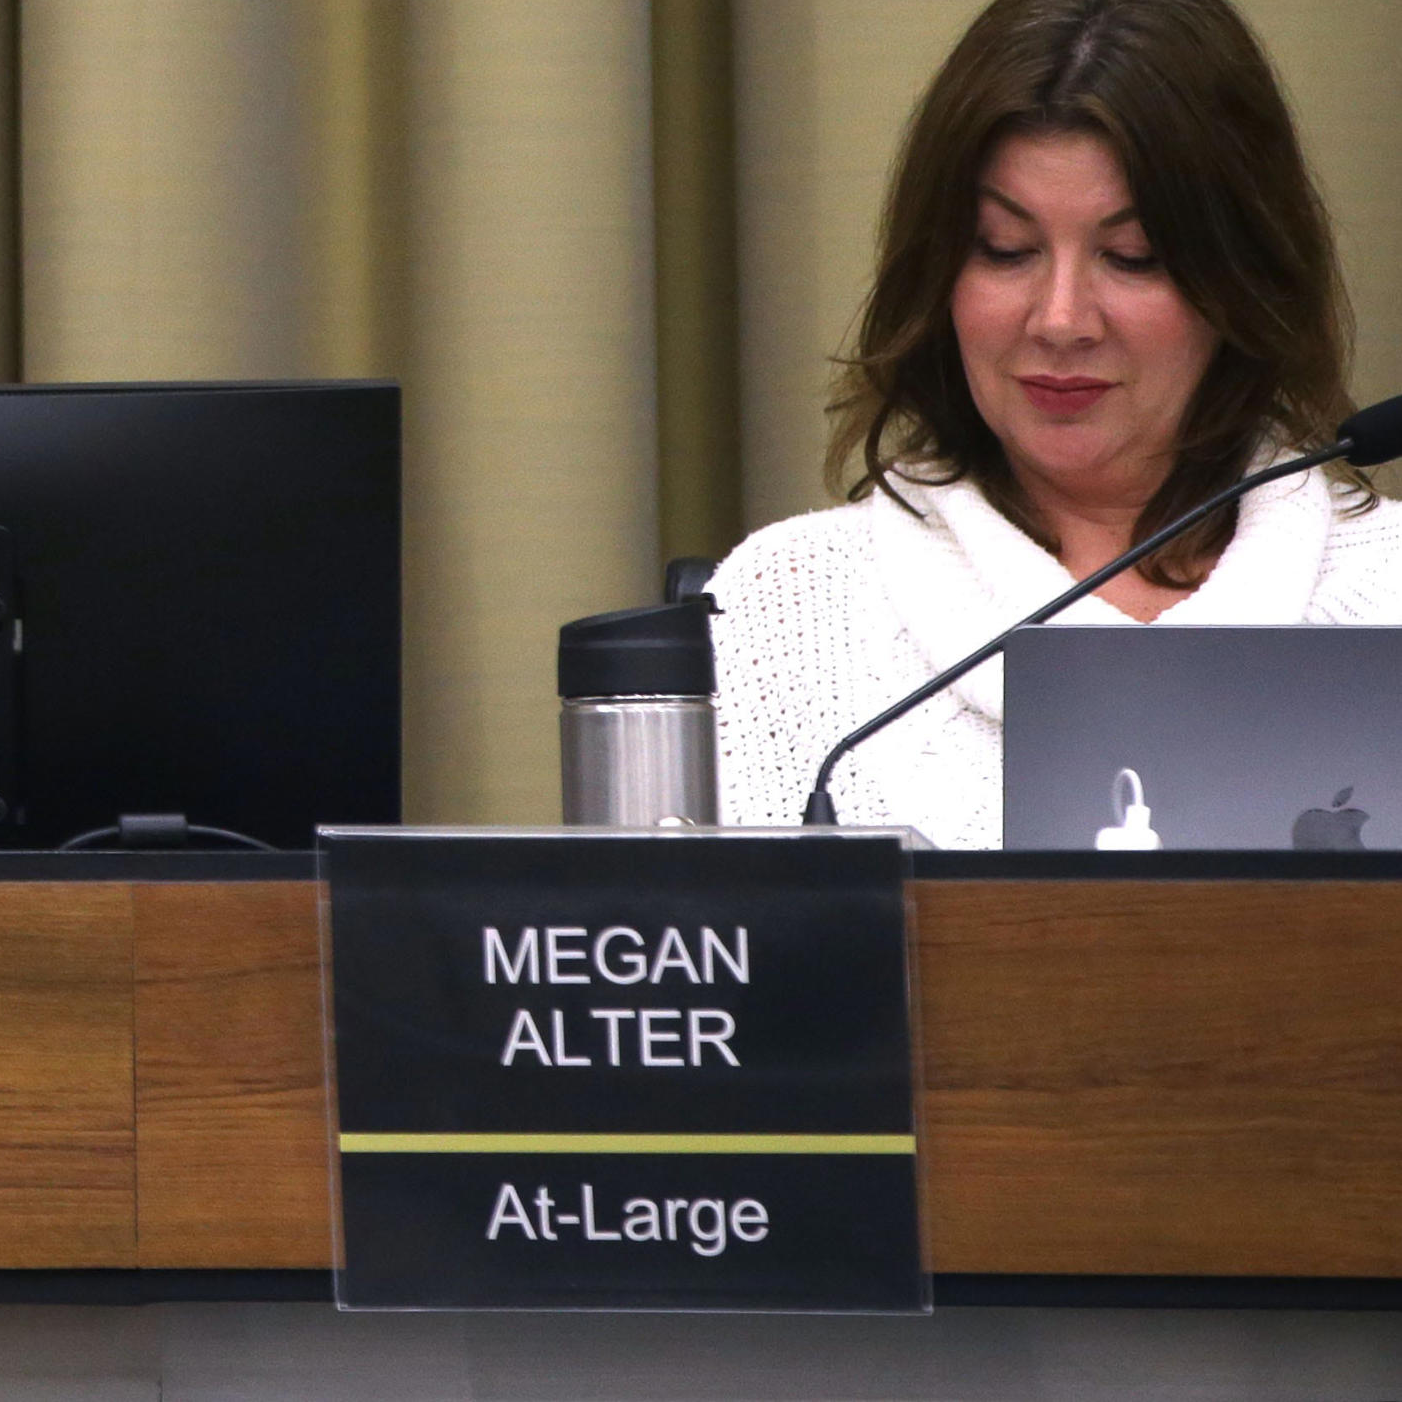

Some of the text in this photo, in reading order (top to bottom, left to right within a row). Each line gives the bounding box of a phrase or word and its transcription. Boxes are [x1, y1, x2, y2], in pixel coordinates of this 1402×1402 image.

[483, 925, 751, 986] MEGAN
[500, 1008, 741, 1068] ALTER
[486, 1182, 770, 1258] At-Large
